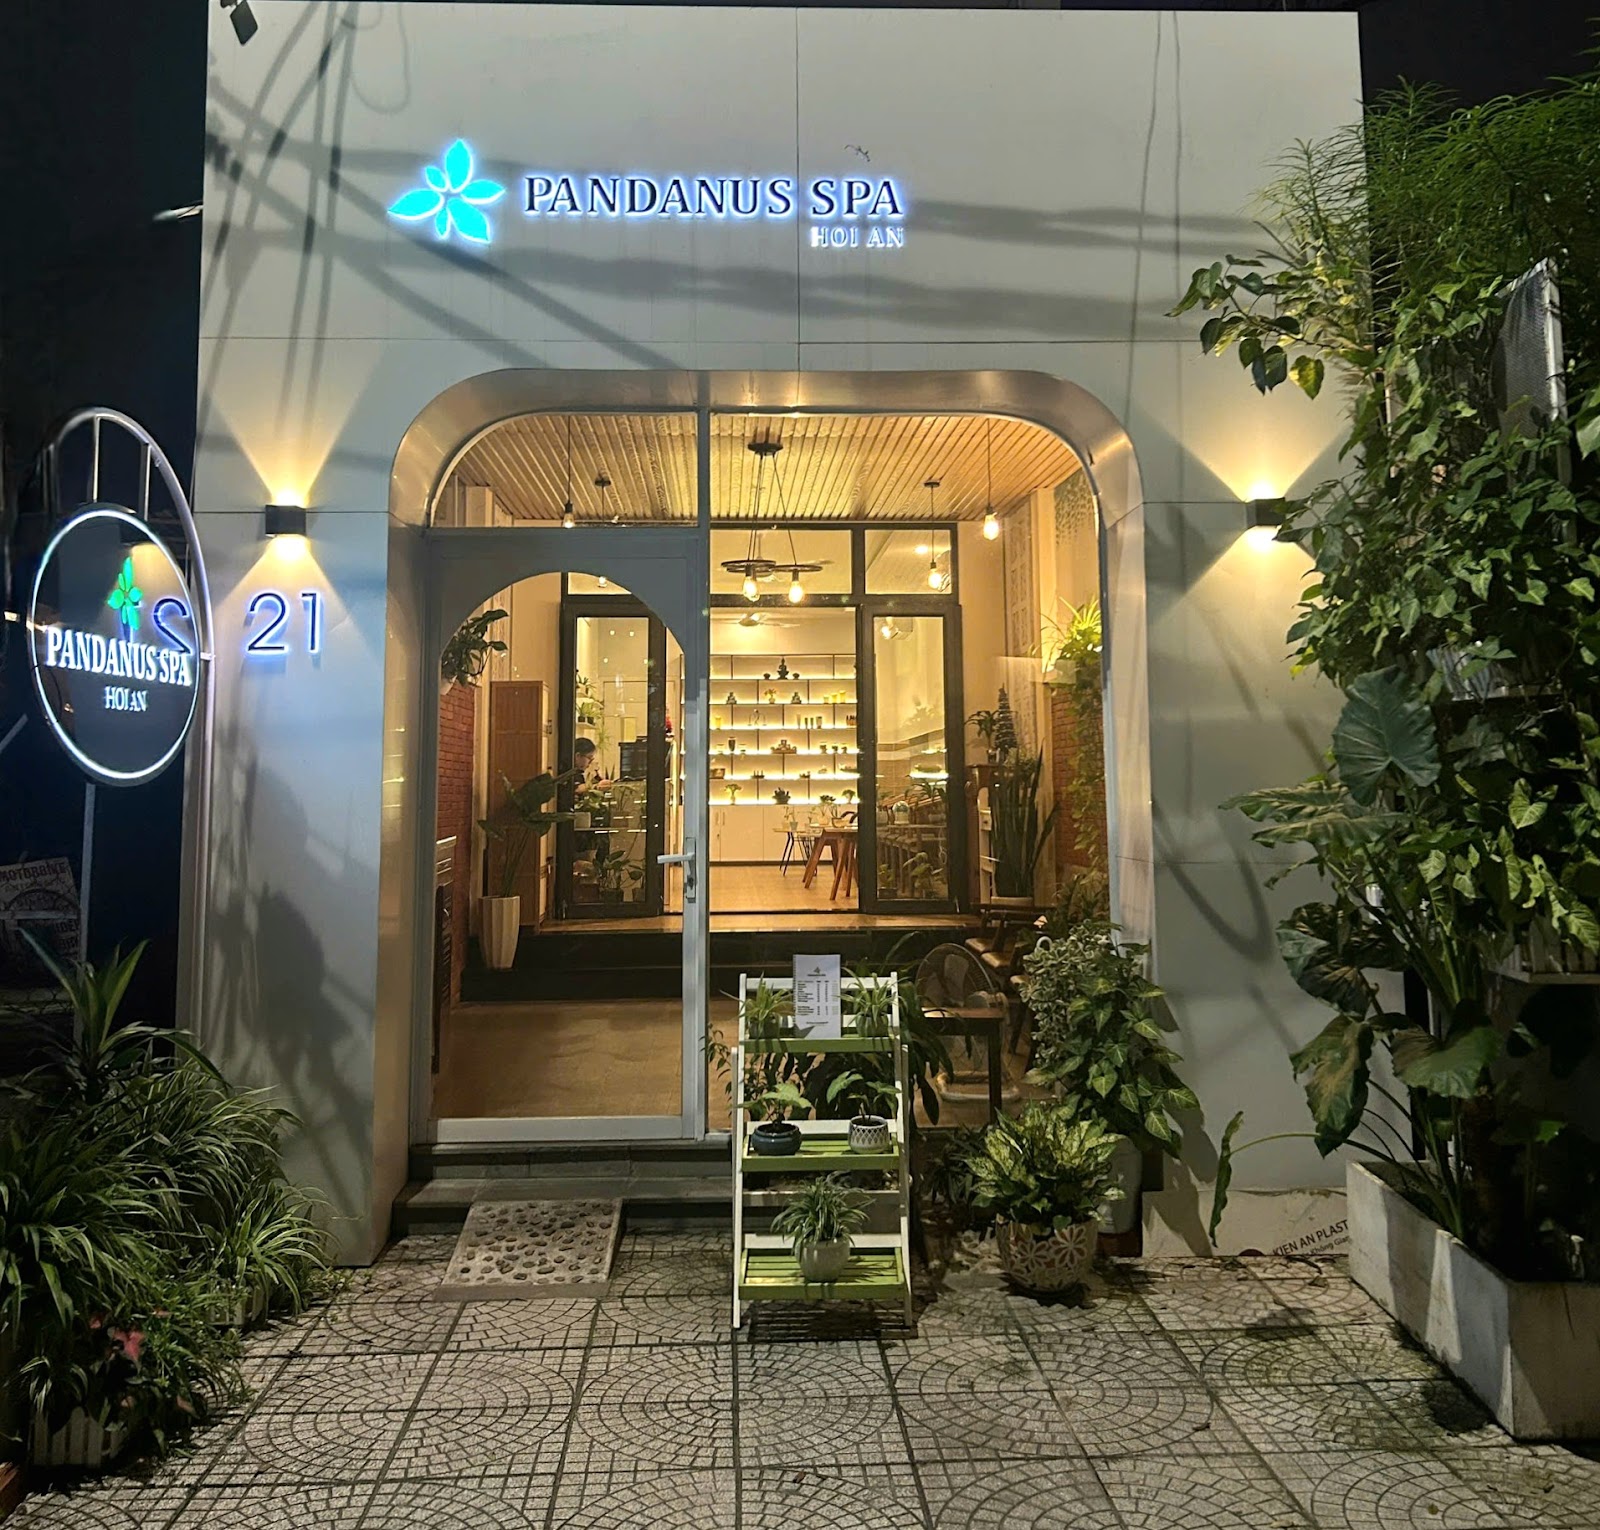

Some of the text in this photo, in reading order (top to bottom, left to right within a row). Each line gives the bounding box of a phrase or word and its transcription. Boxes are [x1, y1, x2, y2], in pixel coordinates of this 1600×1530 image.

[524, 176, 903, 215] PANDANUS SPA
[810, 227, 904, 248] HOI AN
[247, 591, 319, 653] 21
[46, 627, 192, 686] PANDANUS SPA
[105, 686, 148, 712] HOI AN
[1272, 1240, 1298, 1256] KIEN
[1299, 1233, 1316, 1249] AN
